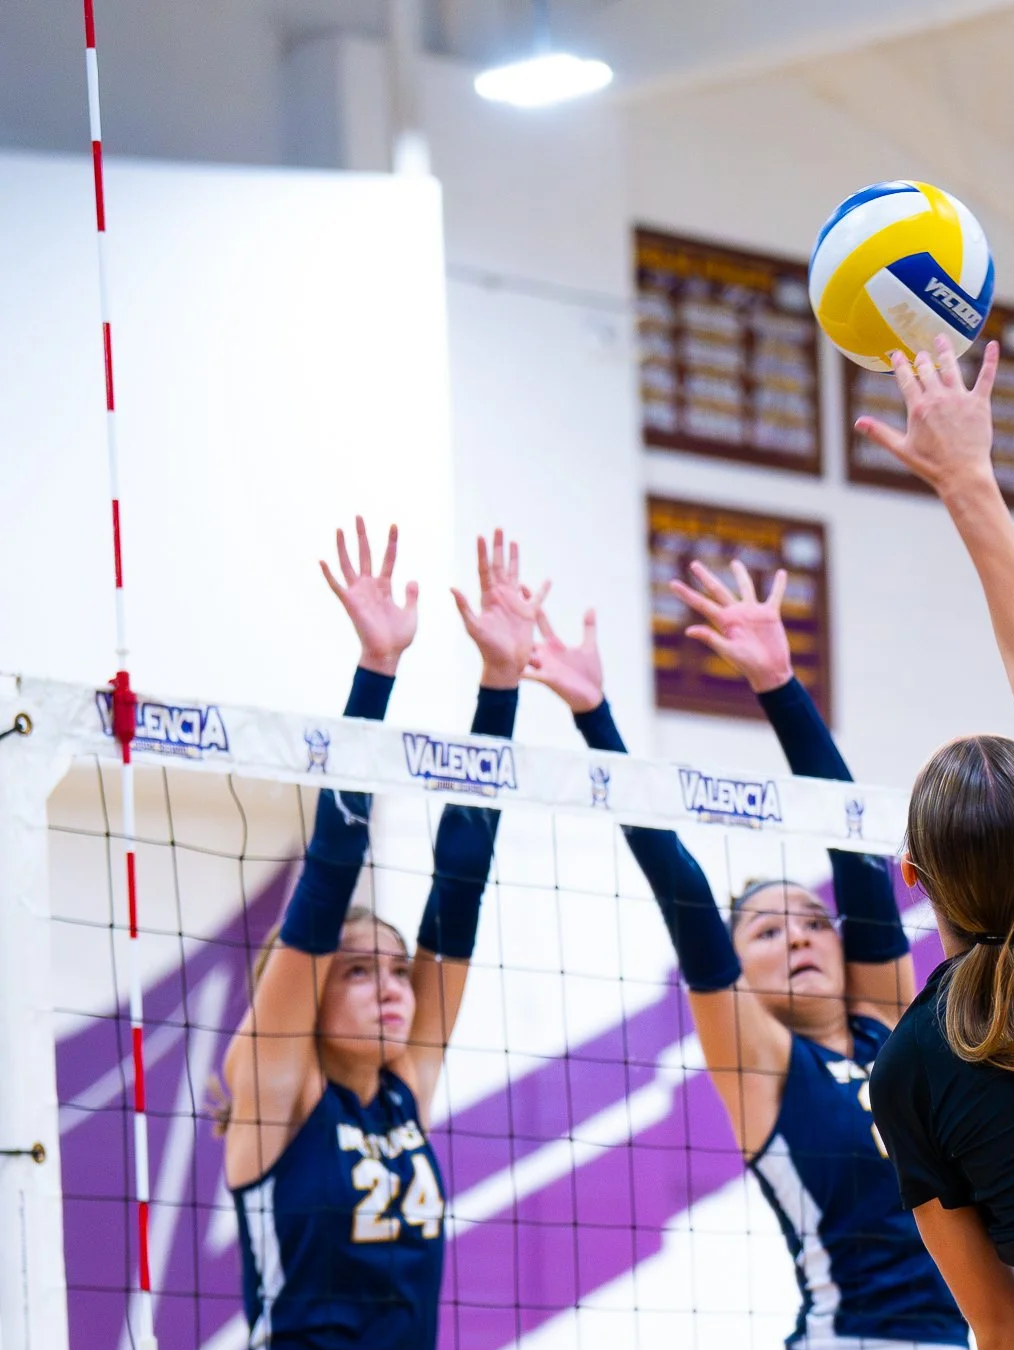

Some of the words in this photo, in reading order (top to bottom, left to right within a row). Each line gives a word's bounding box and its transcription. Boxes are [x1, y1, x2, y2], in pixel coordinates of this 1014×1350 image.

[96, 690, 229, 751] VLENCIA
[402, 732, 518, 790] VALENCIA
[678, 769, 782, 822] VALENCIA
[351, 1153, 445, 1243] 24
